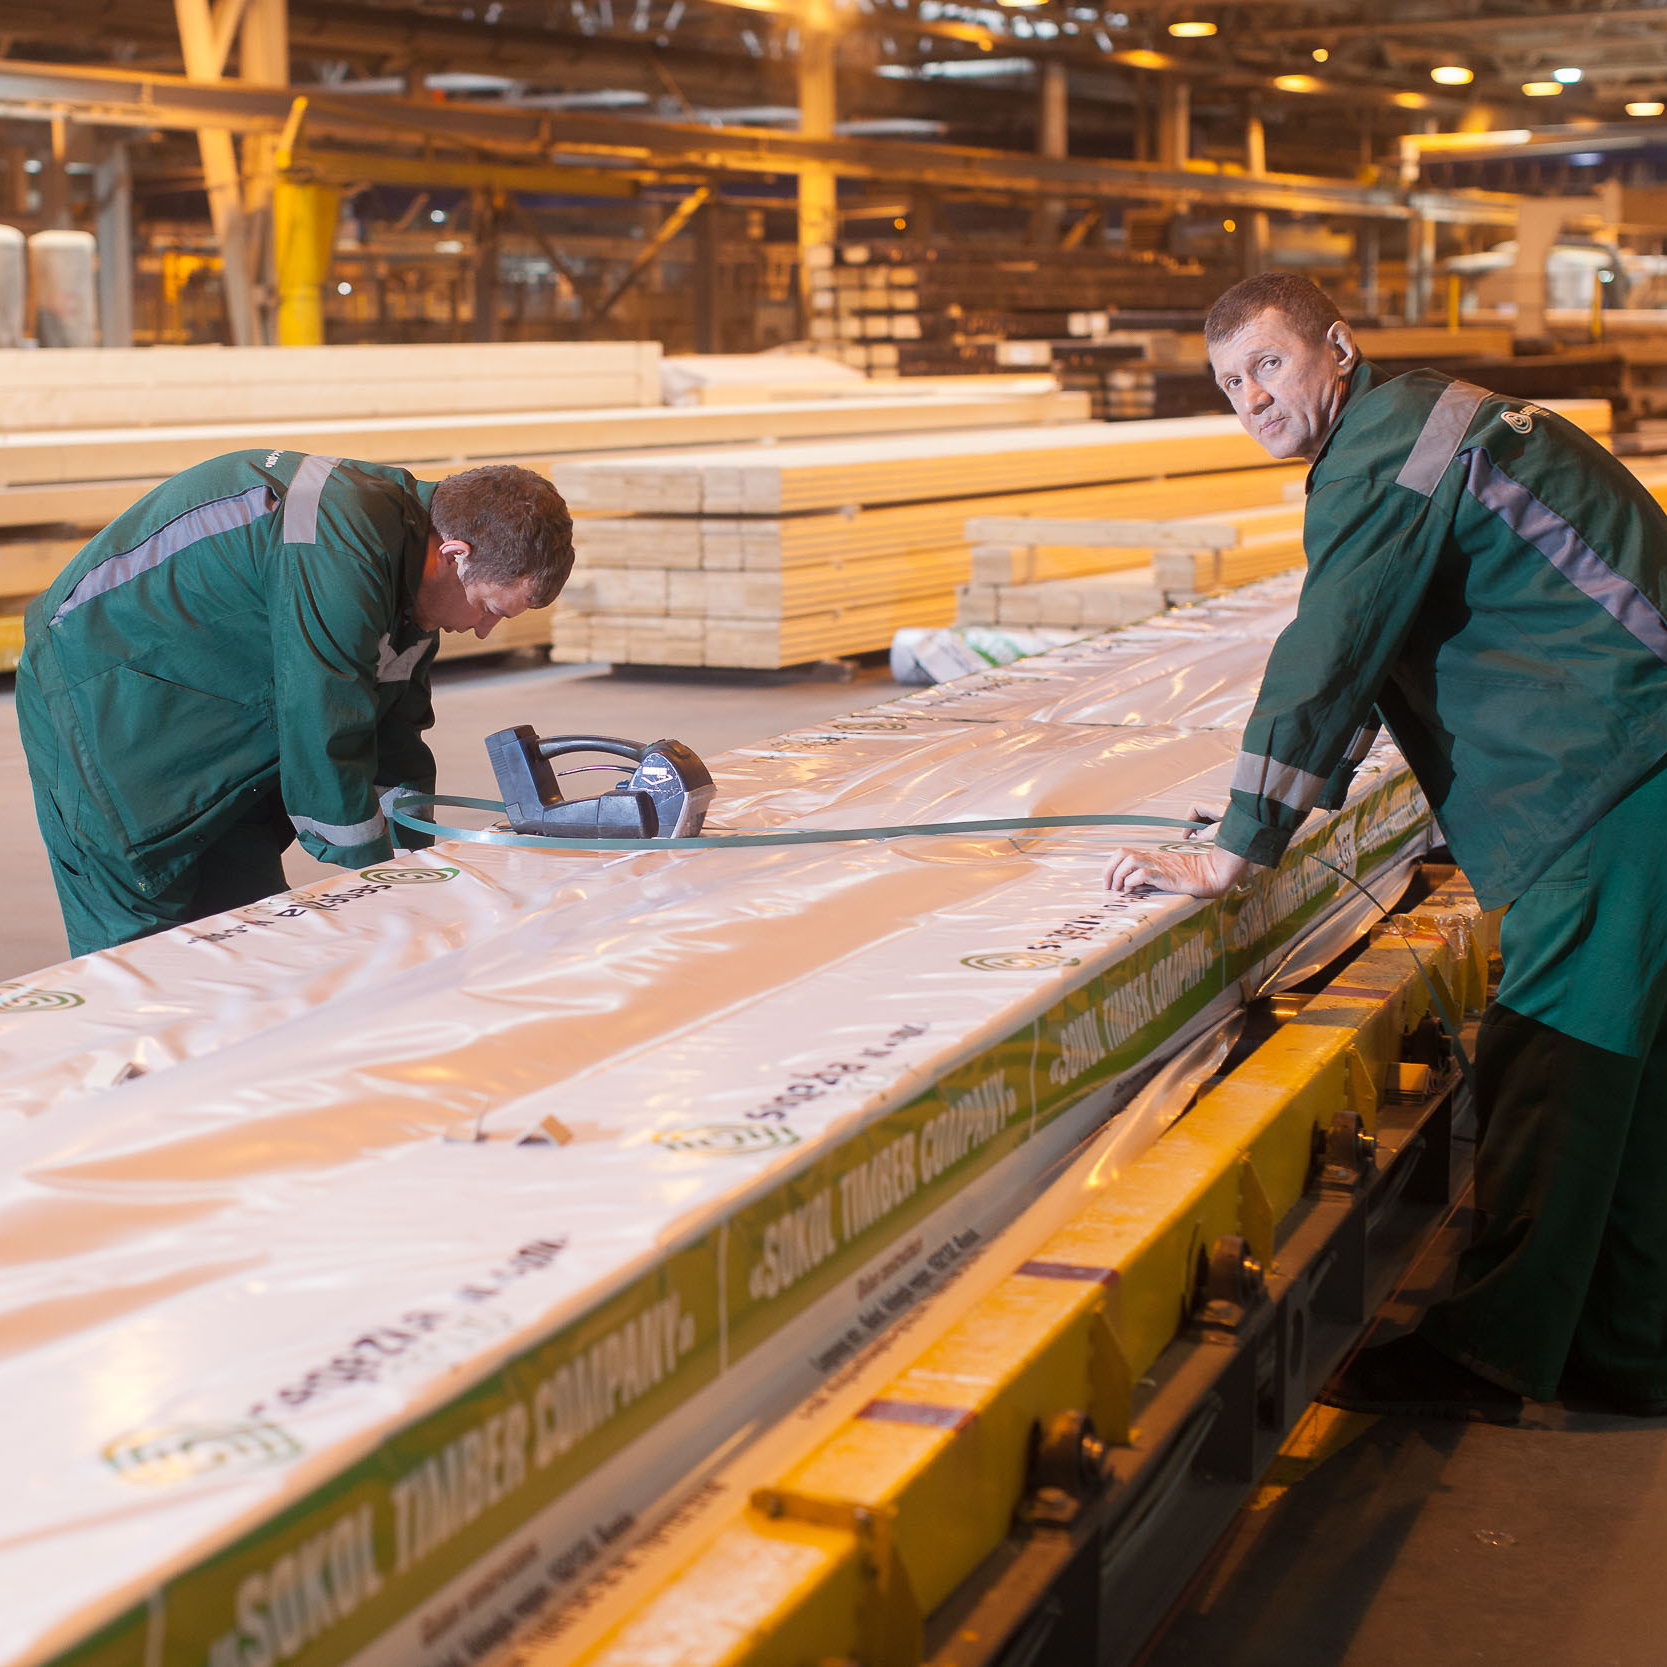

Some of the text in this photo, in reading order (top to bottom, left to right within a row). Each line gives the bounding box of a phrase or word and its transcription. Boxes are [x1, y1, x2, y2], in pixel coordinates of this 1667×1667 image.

[1102, 972, 1152, 1051] TIMBER
[840, 1131, 916, 1243] TIMBER
[392, 1401, 528, 1576] TIMBER
